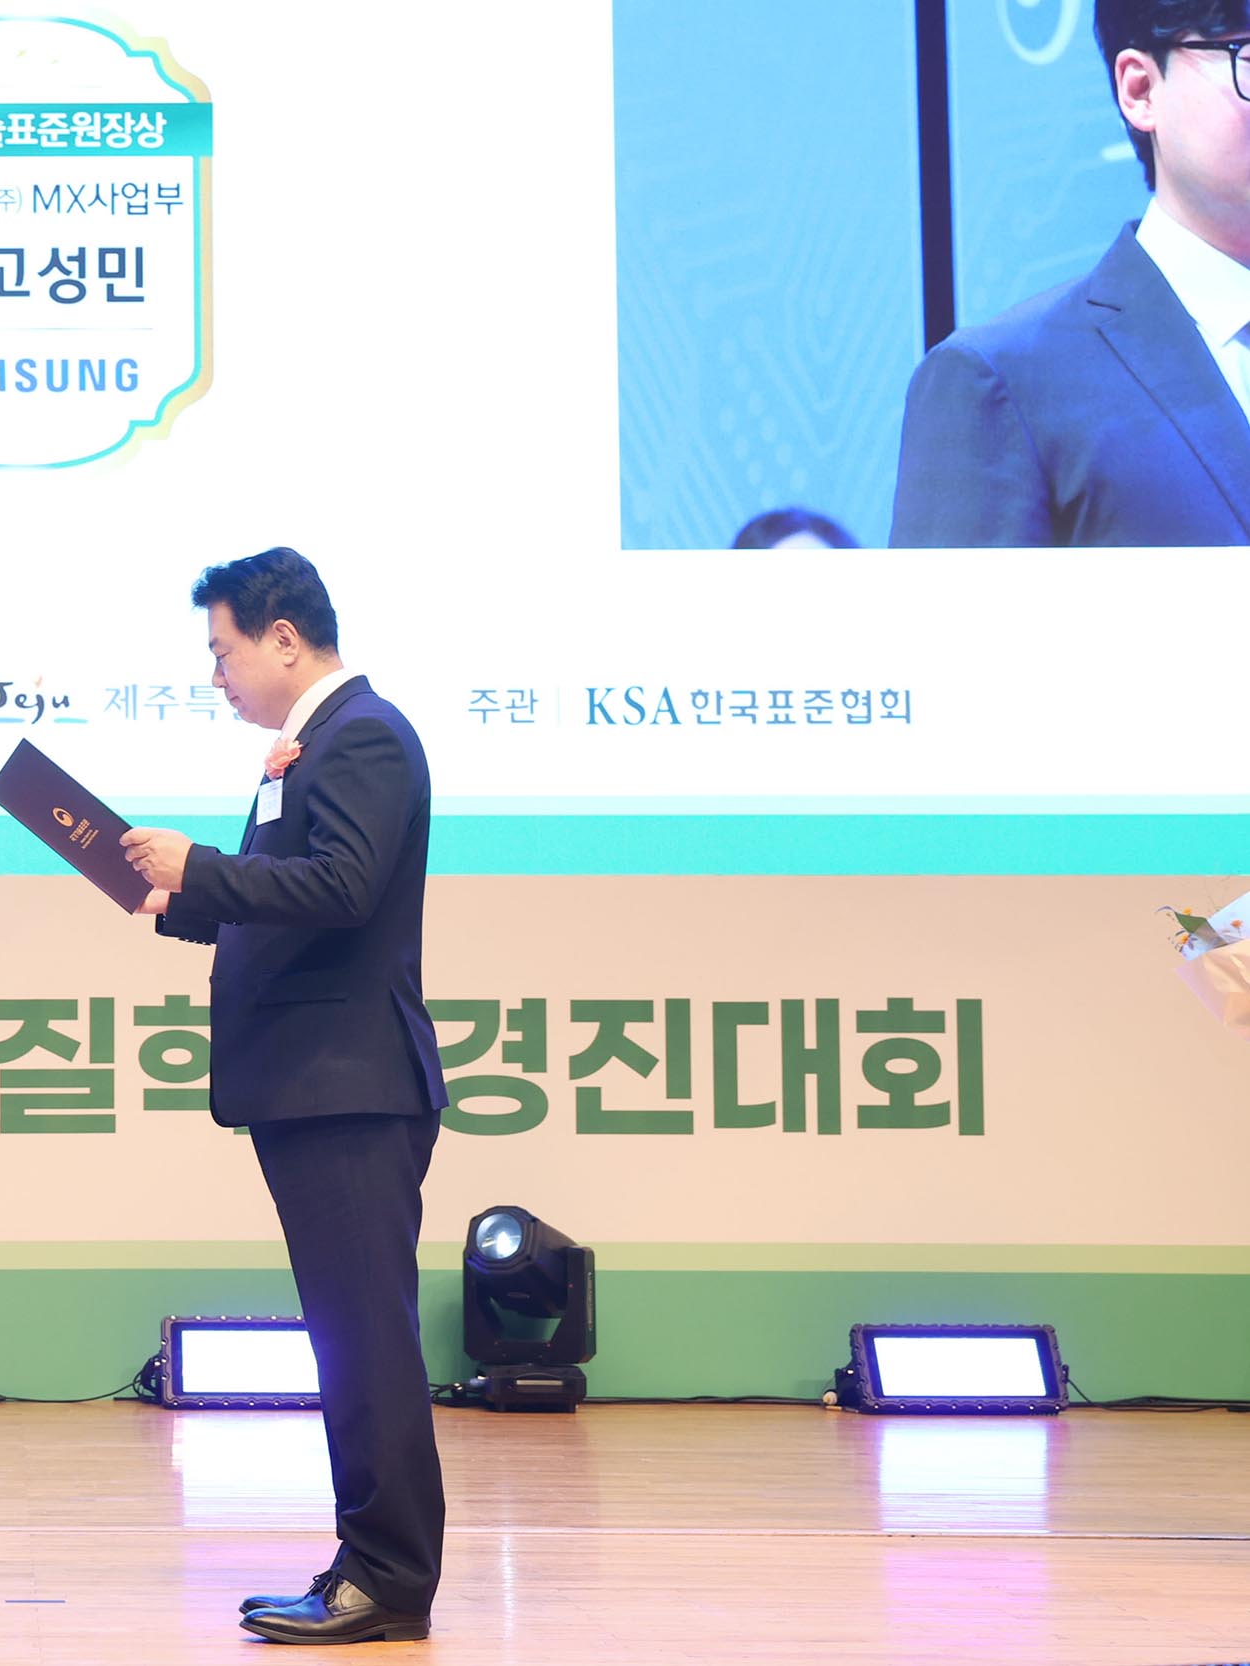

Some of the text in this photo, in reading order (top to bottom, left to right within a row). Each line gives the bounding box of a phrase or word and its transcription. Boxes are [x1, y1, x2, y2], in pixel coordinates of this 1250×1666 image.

[32, 182, 185, 217] MX사업부
[103, 683, 241, 722] 제주특
[468, 686, 912, 726] 주관 KSA 한국표준협회
